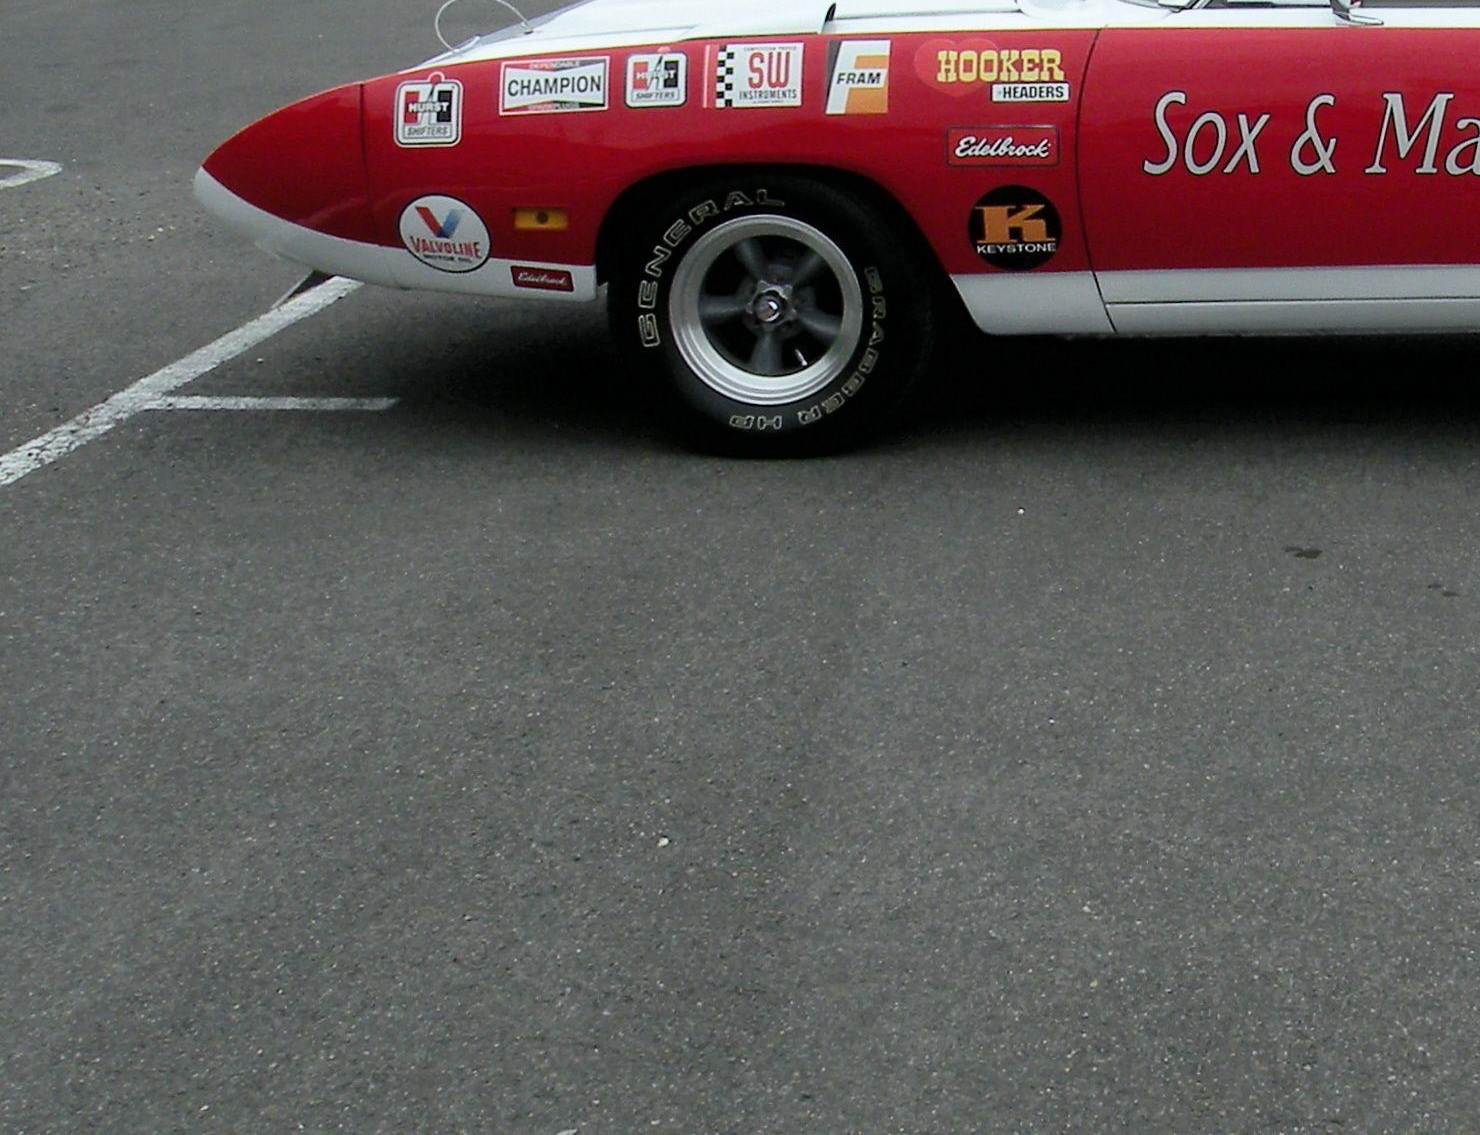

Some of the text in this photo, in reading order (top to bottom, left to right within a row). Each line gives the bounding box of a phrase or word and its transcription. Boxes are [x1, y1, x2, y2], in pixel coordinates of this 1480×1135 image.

[748, 51, 790, 88] SW
[936, 49, 1065, 83] HOOKER
[507, 75, 602, 97] CHAMPION
[836, 73, 881, 84] FRAM
[635, 90, 676, 100] SHIFTERS
[738, 88, 798, 100] INSTRUMENTS
[1002, 85, 1065, 99] HEADERS
[408, 102, 449, 113] HURST
[407, 126, 449, 136] SHIFTERS
[1143, 91, 1270, 175] Sox
[1290, 93, 1338, 175] &
[954, 136, 1051, 158] Edelbrock
[410, 235, 482, 260] VALVOLINE
[976, 242, 1057, 254] KEYSTONE
[638, 188, 786, 348] GENERAL
[729, 415, 783, 430] HP
